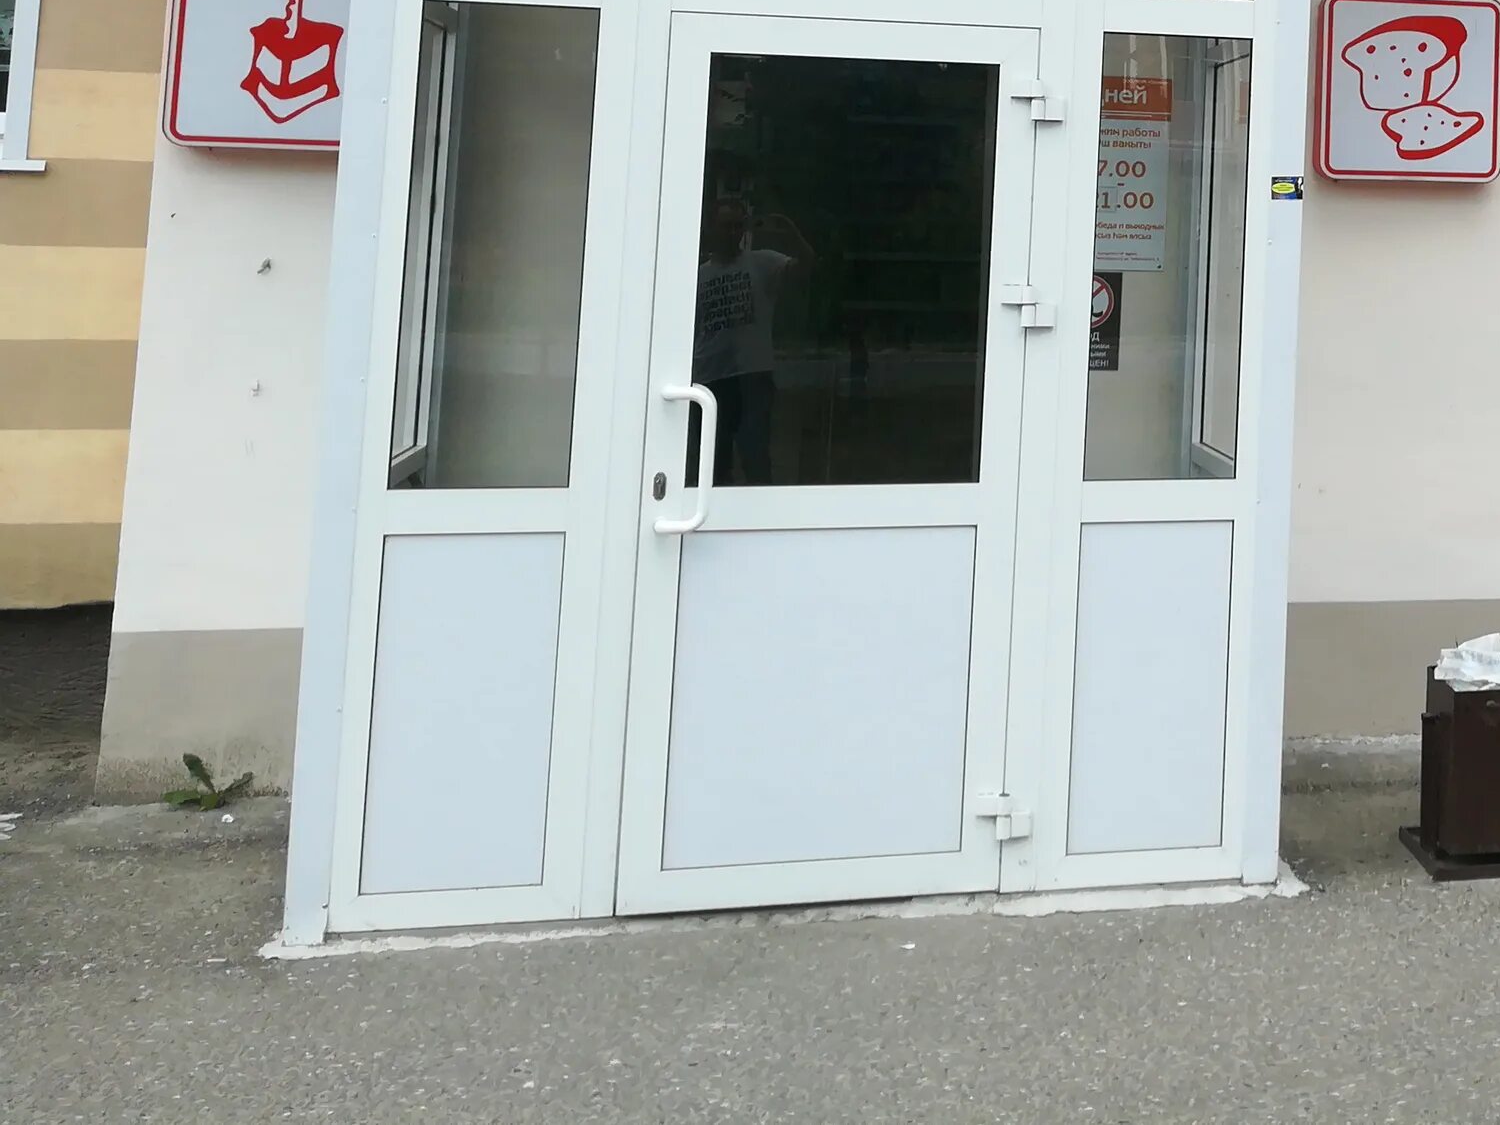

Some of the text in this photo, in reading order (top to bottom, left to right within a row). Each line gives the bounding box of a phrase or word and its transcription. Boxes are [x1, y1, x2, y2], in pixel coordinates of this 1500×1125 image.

[1101, 85, 1147, 105] ней
[1122, 127, 1161, 137] работы
[1096, 191, 1155, 209] 1.00
